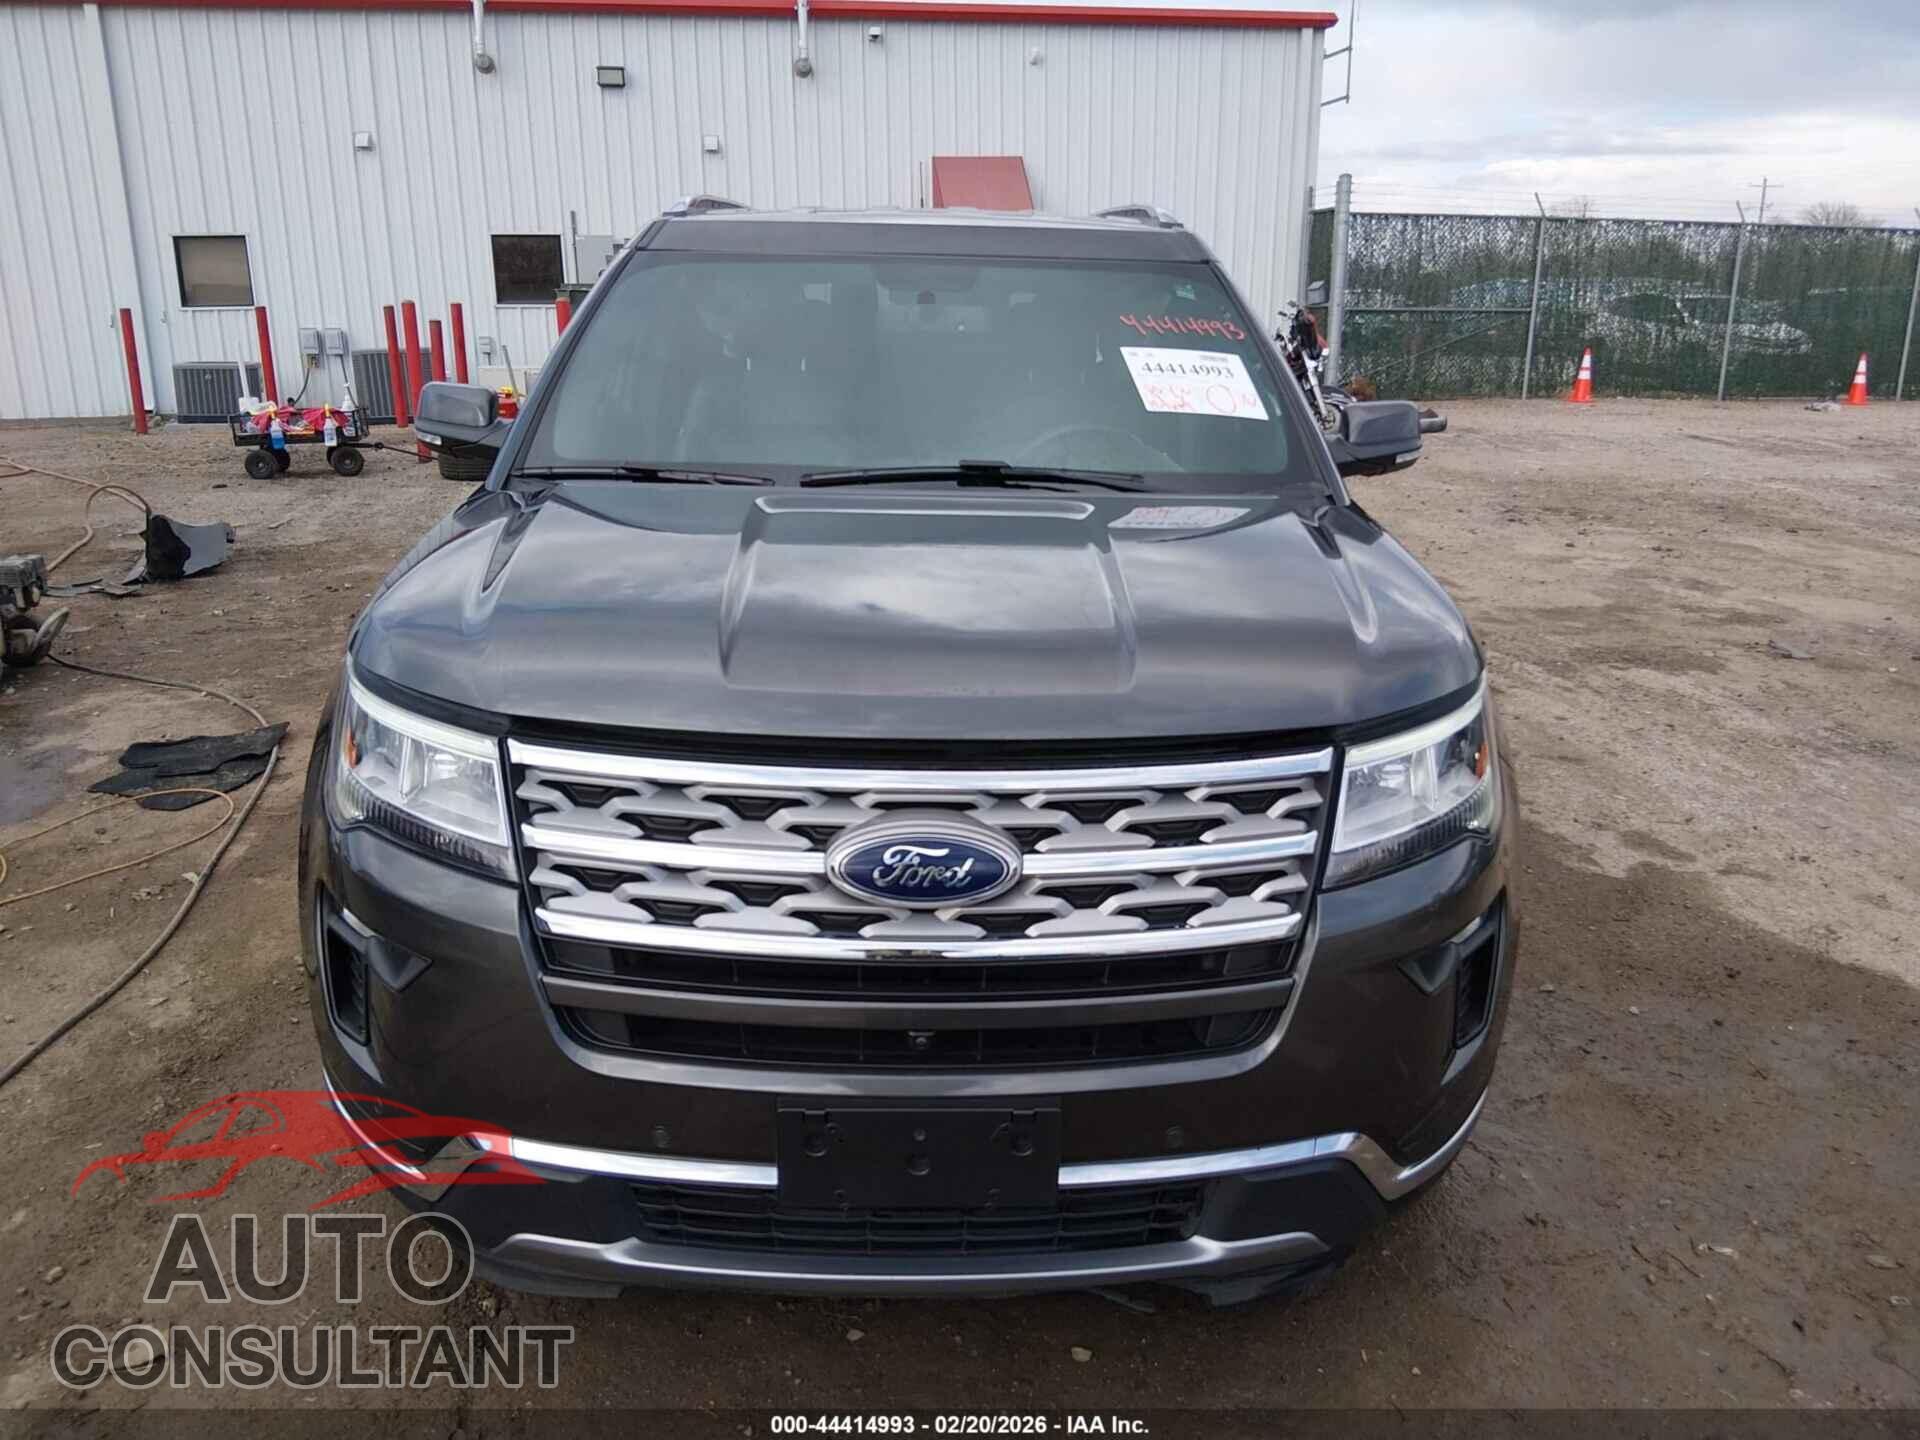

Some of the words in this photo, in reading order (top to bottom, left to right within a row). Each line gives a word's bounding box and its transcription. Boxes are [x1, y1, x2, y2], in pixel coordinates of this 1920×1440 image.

[1120, 313, 1246, 340] 44414993
[1141, 361, 1235, 379] 44414993
[872, 845, 975, 887] Ford
